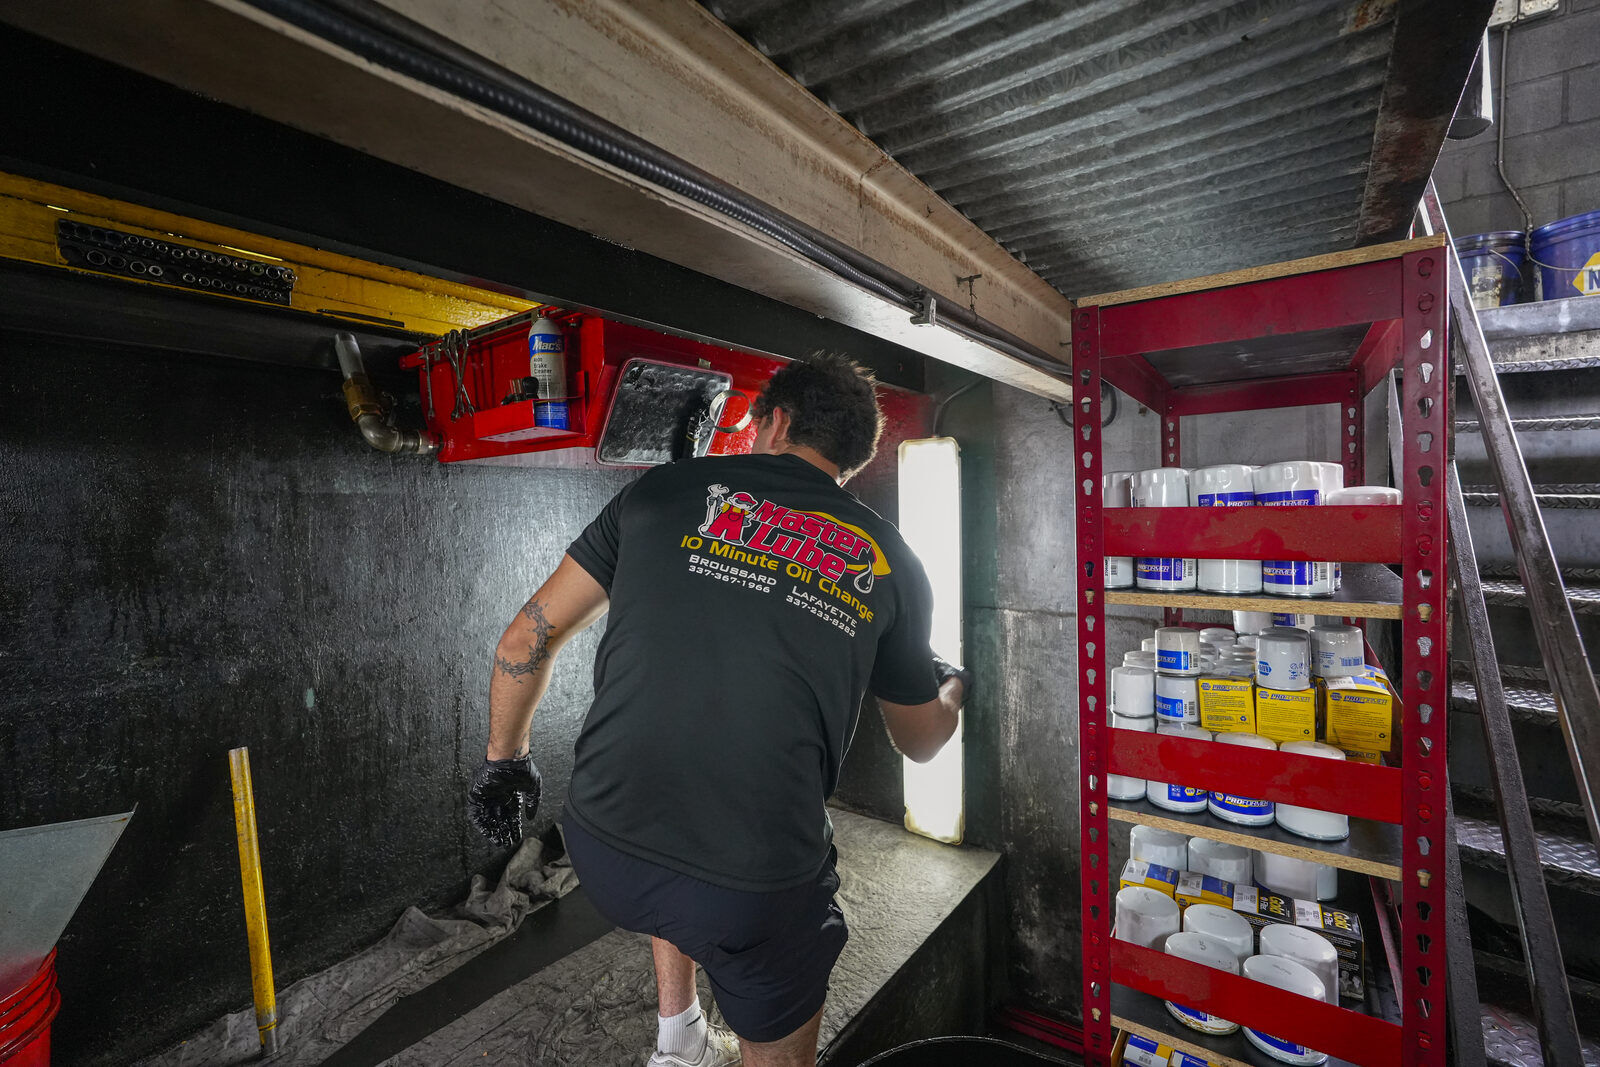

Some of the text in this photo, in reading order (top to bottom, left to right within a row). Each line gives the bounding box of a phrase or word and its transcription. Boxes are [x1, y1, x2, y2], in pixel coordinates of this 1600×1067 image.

[532, 335, 561, 351] Mac's
[753, 499, 872, 560] Master
[744, 522, 847, 583] Lube
[680, 535, 874, 623] 10 Minute Oil Change
[688, 565, 770, 594] 337-367-1966
[689, 554, 777, 586] BROUSSARD
[792, 585, 858, 628] LAFAYETTE
[1269, 895, 1286, 916] Gold
[1333, 911, 1353, 932] Gold
